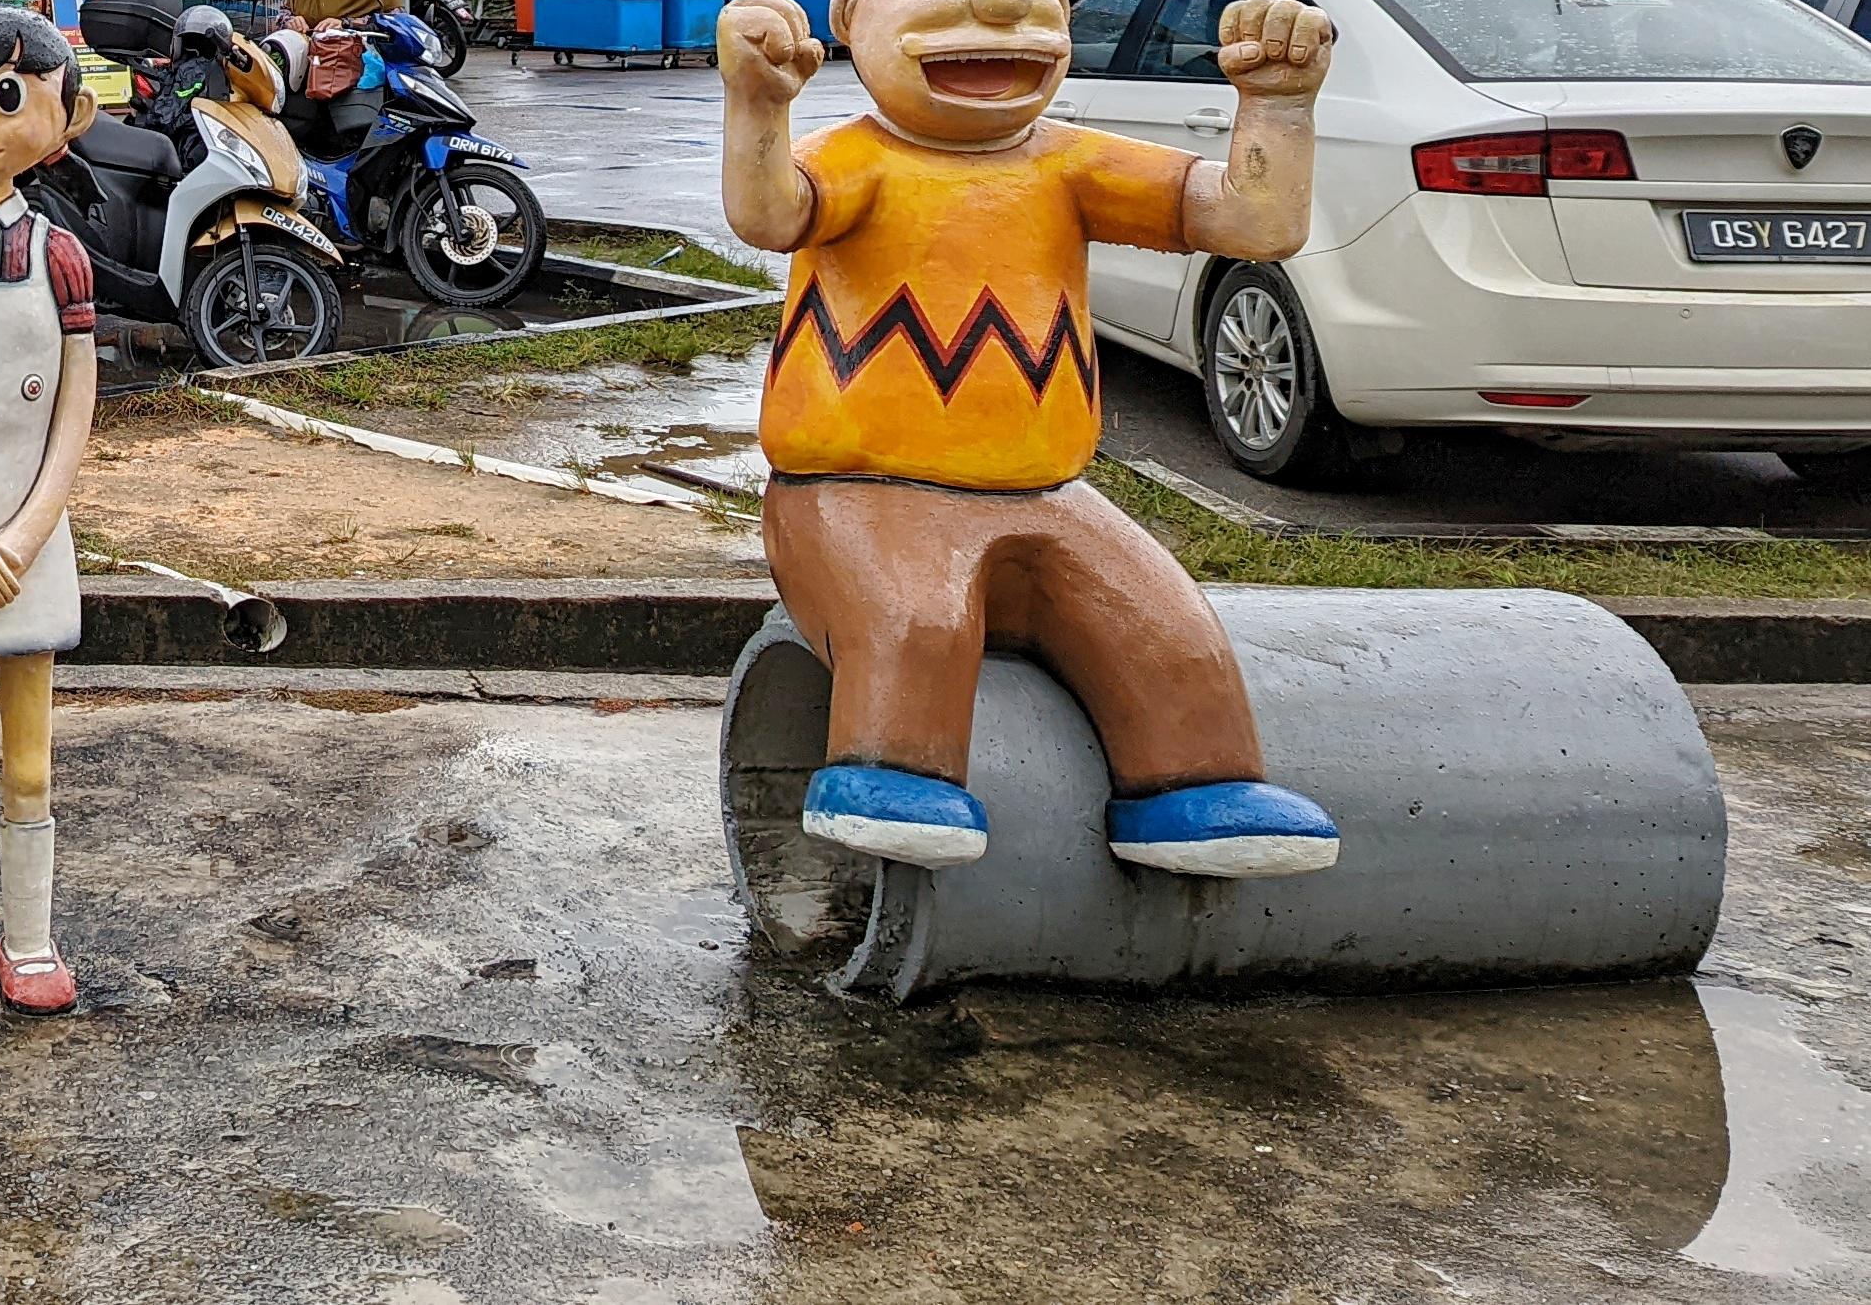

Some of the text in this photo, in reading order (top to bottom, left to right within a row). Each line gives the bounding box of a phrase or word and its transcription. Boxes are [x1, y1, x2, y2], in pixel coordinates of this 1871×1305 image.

[448, 136, 514, 162] QRM 6174
[1710, 220, 1867, 249] QSY 6427
